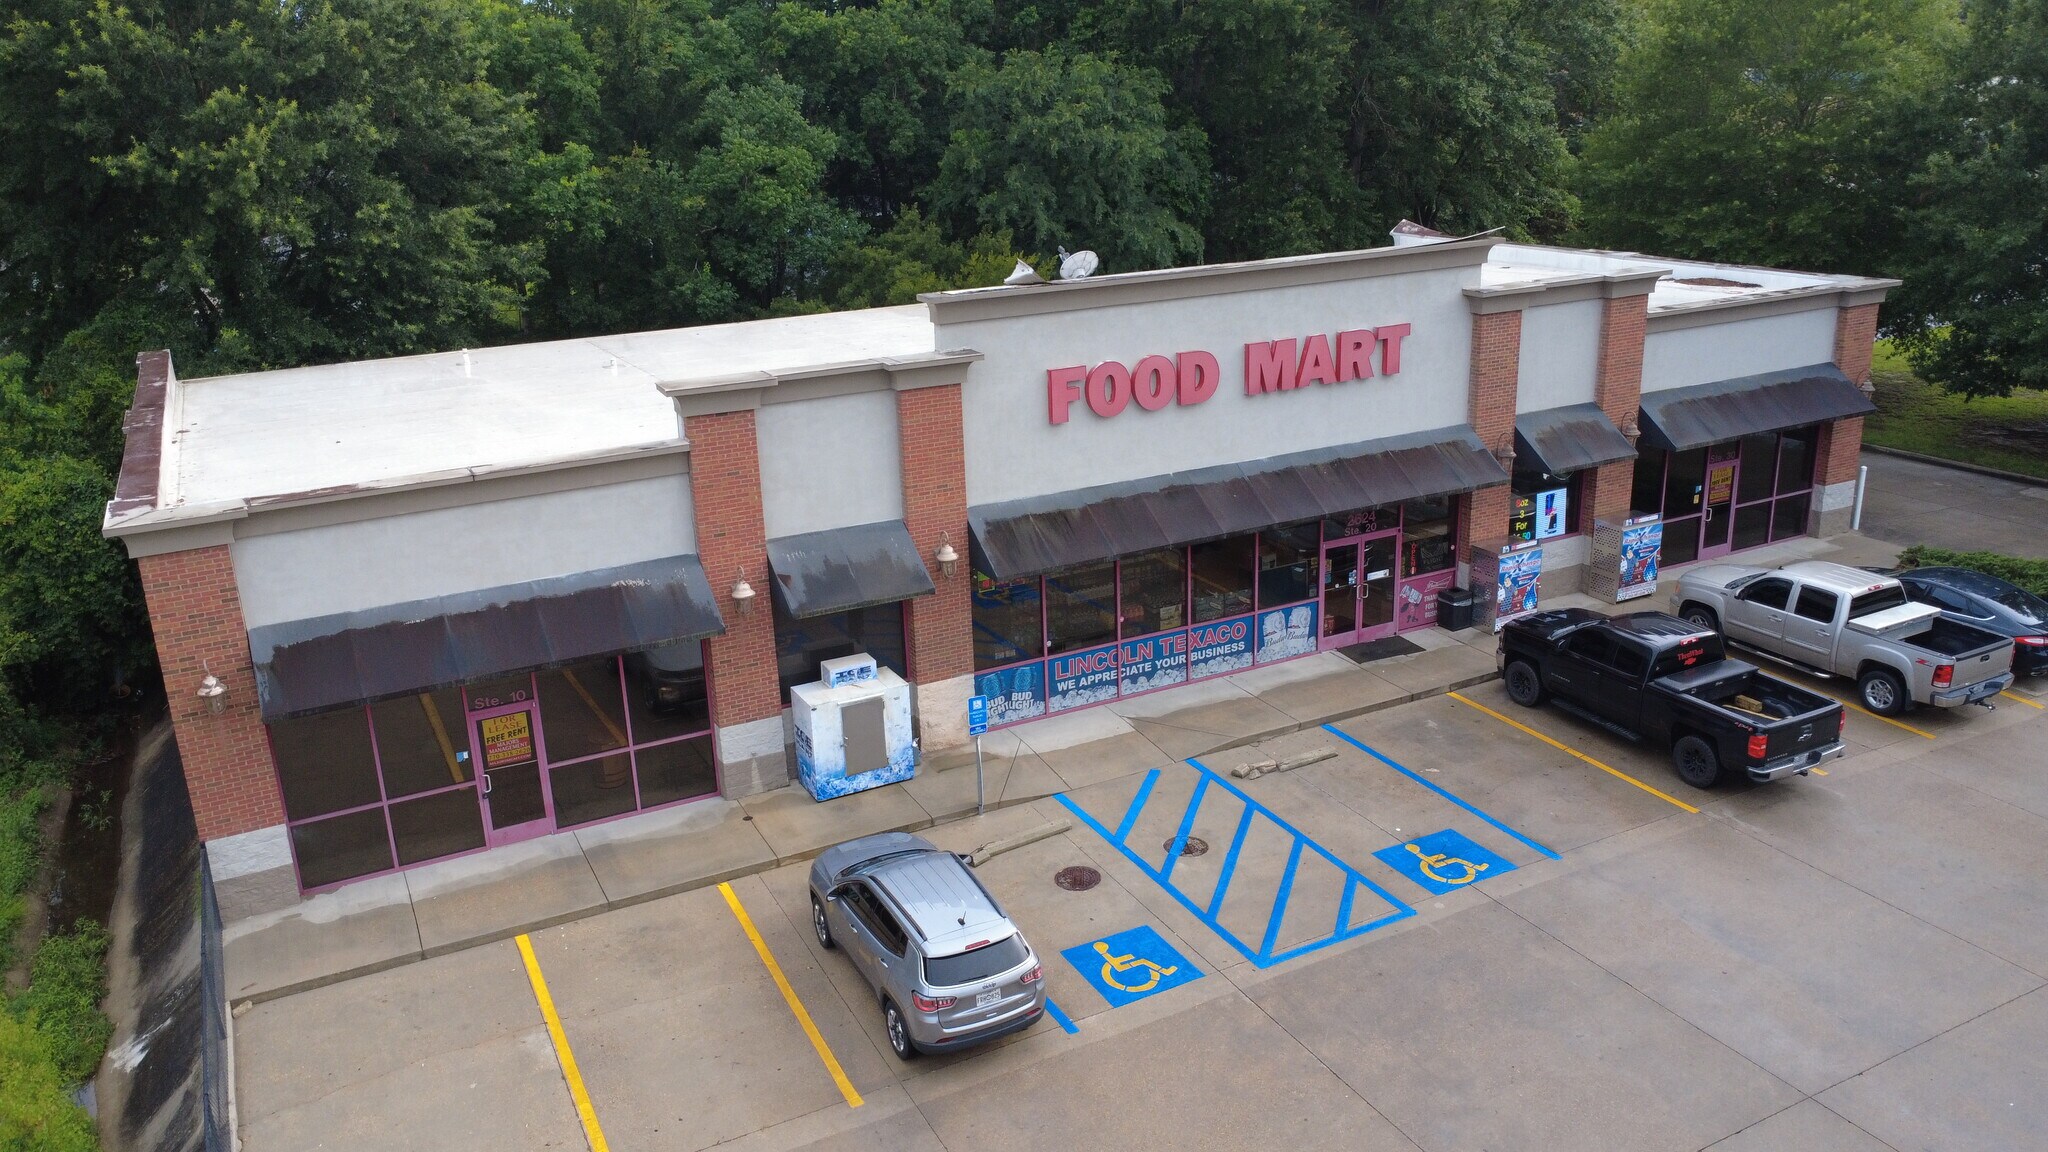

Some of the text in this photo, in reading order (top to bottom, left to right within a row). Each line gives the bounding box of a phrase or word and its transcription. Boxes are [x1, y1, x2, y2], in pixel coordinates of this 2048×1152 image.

[1047, 322, 1411, 424] FOOD MART
[1344, 523, 1377, 537] Ste. 20
[1516, 522, 1528, 531] For
[1055, 622, 1246, 680] LINCOLN TEXACO
[835, 665, 872, 680] ICE
[1057, 641, 1245, 692] WE APPRECIATE YOUR BUSINESS
[475, 690, 526, 709] Ste. 10
[1012, 692, 1032, 701] BUD
[988, 701, 1010, 718] IGHT
[1009, 699, 1034, 712] LIGHT
[489, 721, 523, 733] LEASE
[492, 715, 516, 725] FOR
[486, 726, 527, 744] FREE RENT
[489, 742, 528, 754] MANAGEMENT
